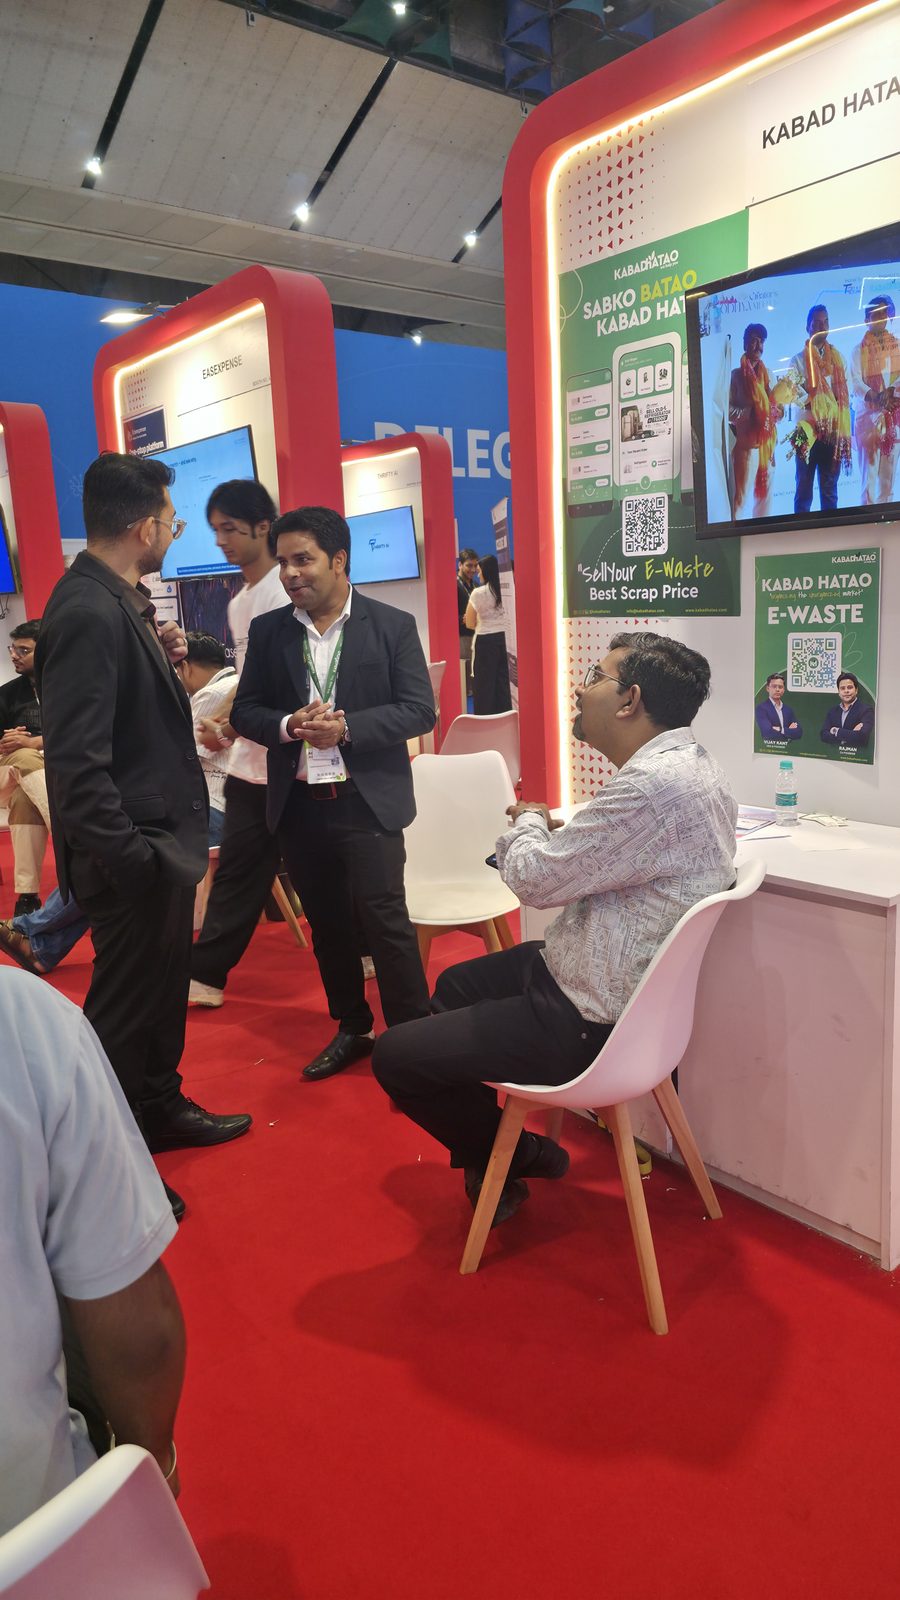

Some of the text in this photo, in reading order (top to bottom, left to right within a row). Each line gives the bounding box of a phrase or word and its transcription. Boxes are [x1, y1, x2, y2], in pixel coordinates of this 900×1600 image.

[763, 103, 836, 149] KABAD
[583, 269, 697, 320] SABKO BATAO
[596, 305, 652, 337] KABAD
[202, 355, 243, 380] EASEXPENSE
[644, 554, 715, 582] E-Waste
[589, 582, 699, 602] Best Scrap Price
[761, 572, 872, 592] KABAD HATAO
[768, 604, 864, 625] E-WASTE
